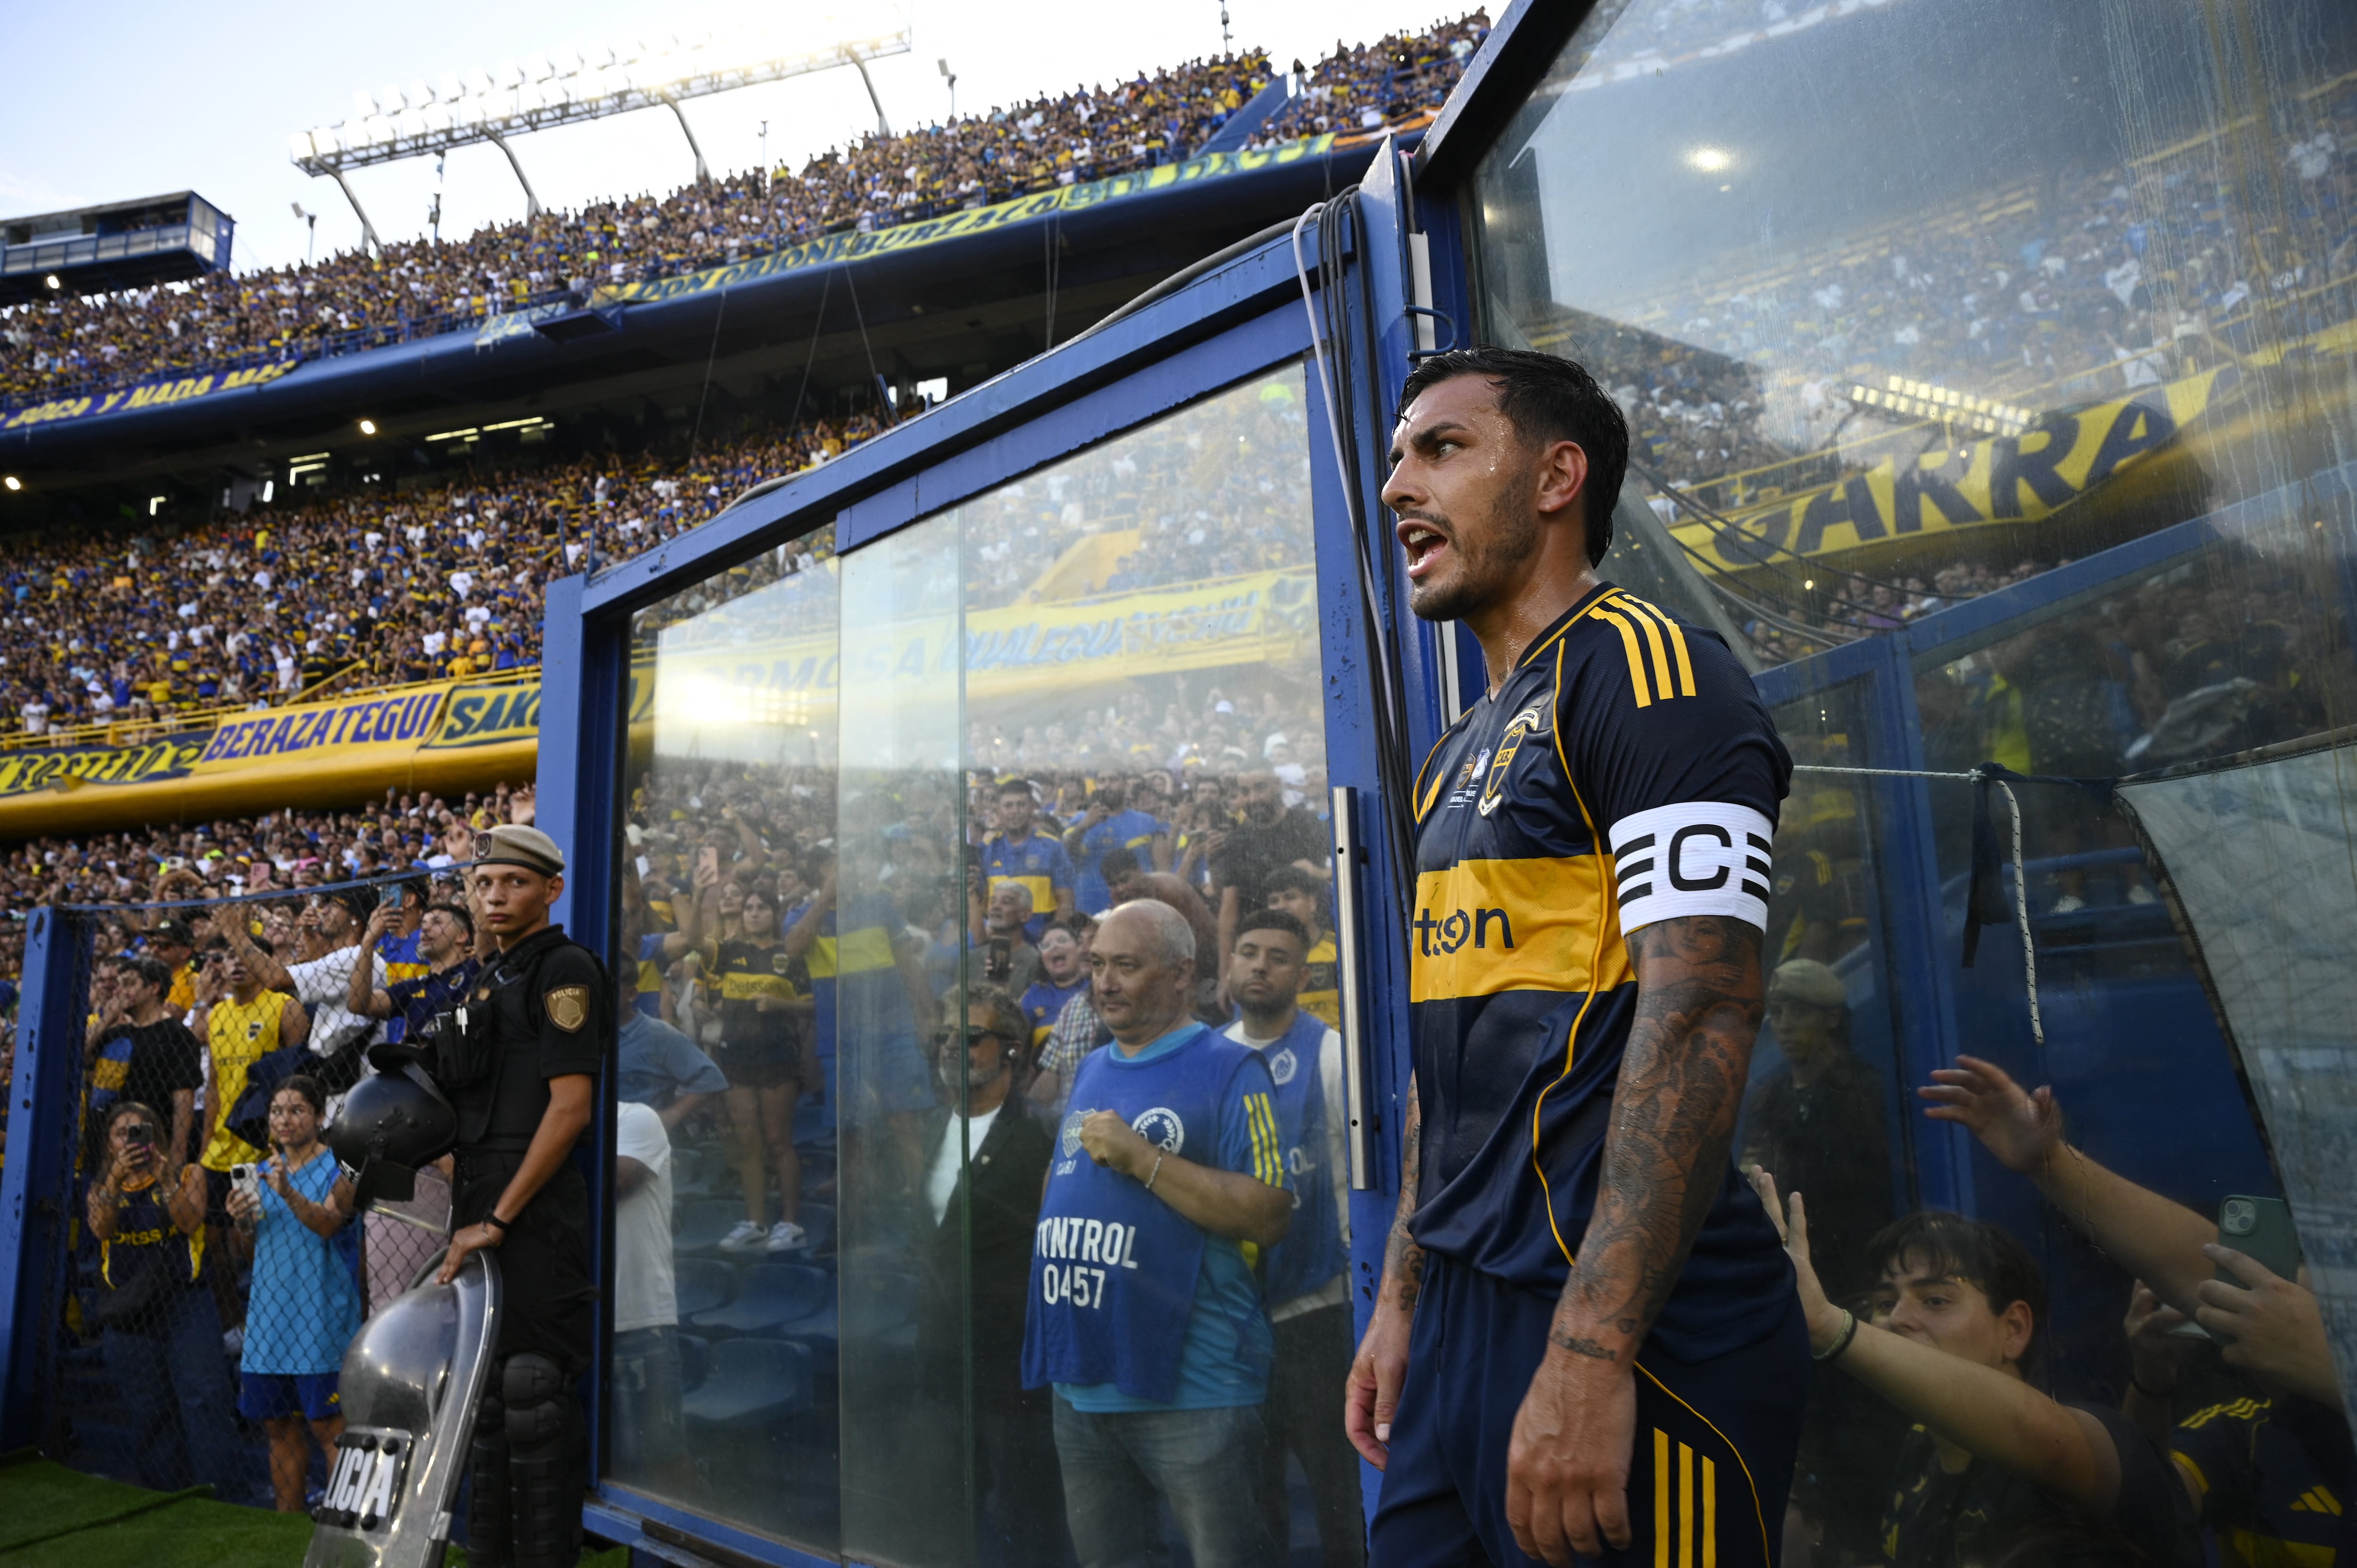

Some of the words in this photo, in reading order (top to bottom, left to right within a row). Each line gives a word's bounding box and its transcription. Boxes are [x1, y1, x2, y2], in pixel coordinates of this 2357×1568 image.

[201, 692, 443, 763] BERAZATEGUI
[1668, 824, 1732, 891] C
[1044, 1264, 1105, 1309] 0457
